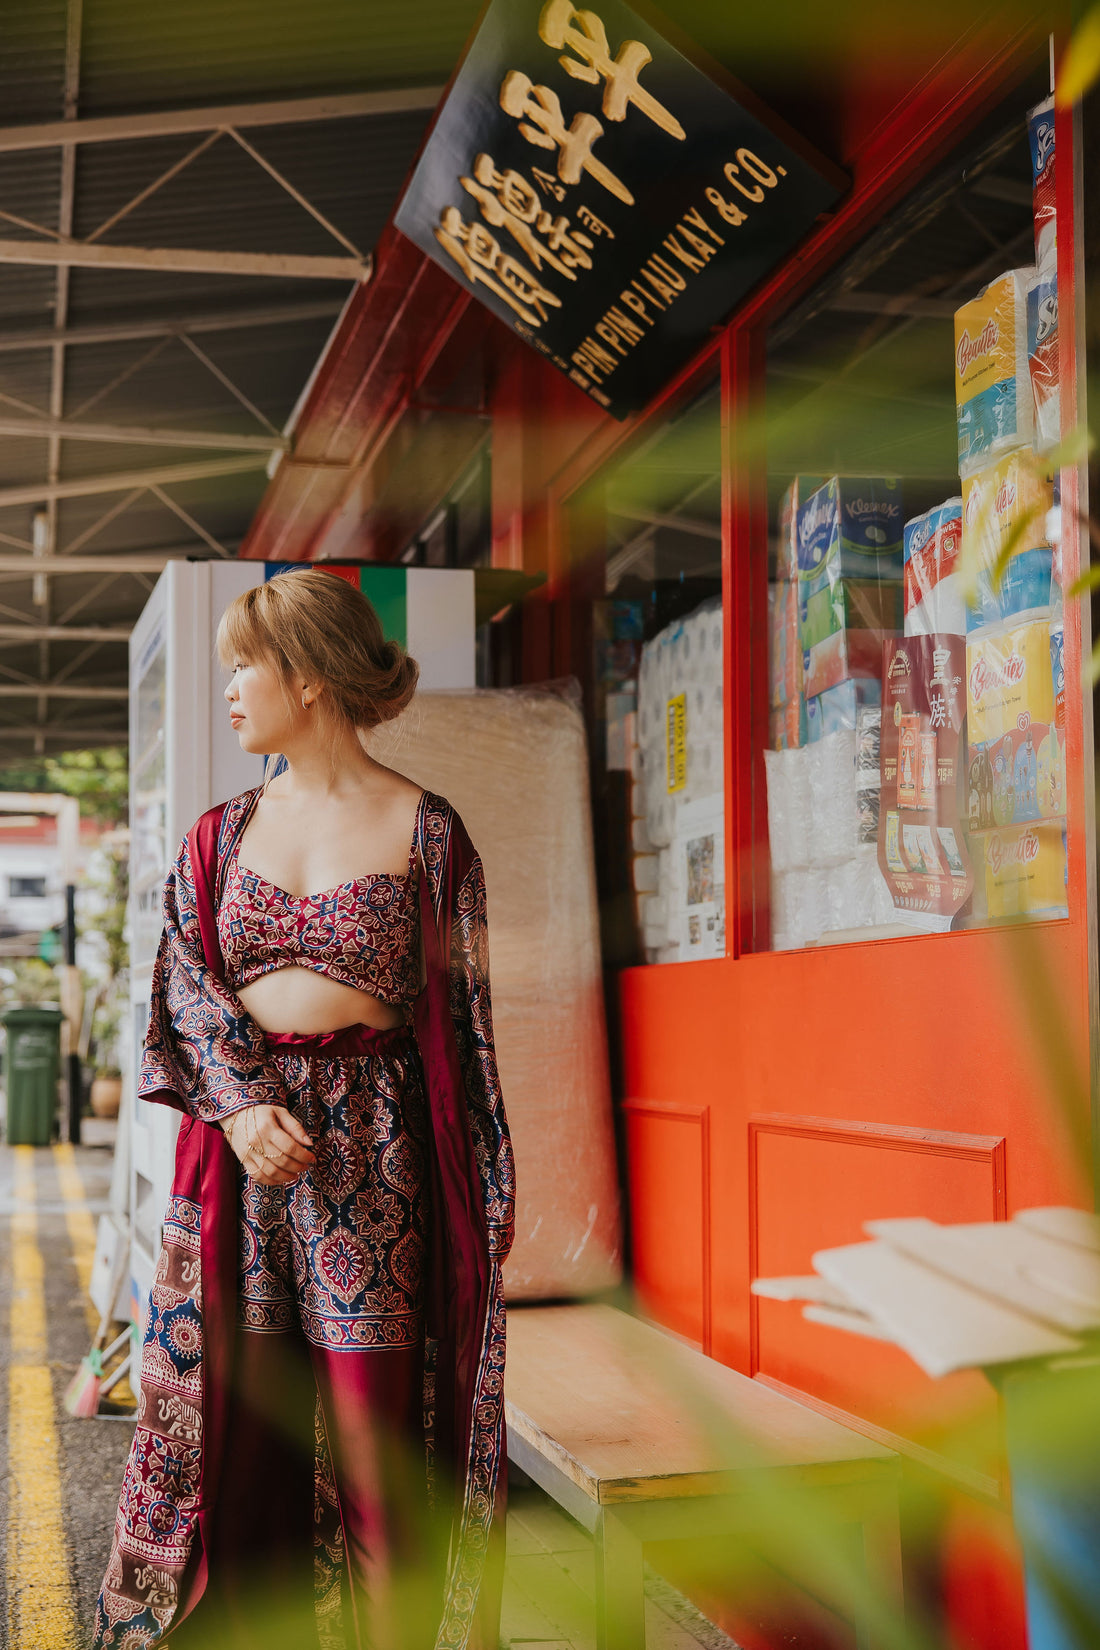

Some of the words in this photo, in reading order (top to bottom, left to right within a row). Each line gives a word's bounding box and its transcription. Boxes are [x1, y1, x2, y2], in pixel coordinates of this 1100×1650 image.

[723, 147, 788, 203] CO.
[704, 186, 748, 227] &
[662, 206, 725, 274] KAY
[595, 305, 645, 356] PIN
[957, 317, 999, 377] Beautex
[570, 336, 619, 384] PIN
[845, 498, 899, 519] Kleenex
[929, 644, 951, 728] 皇族
